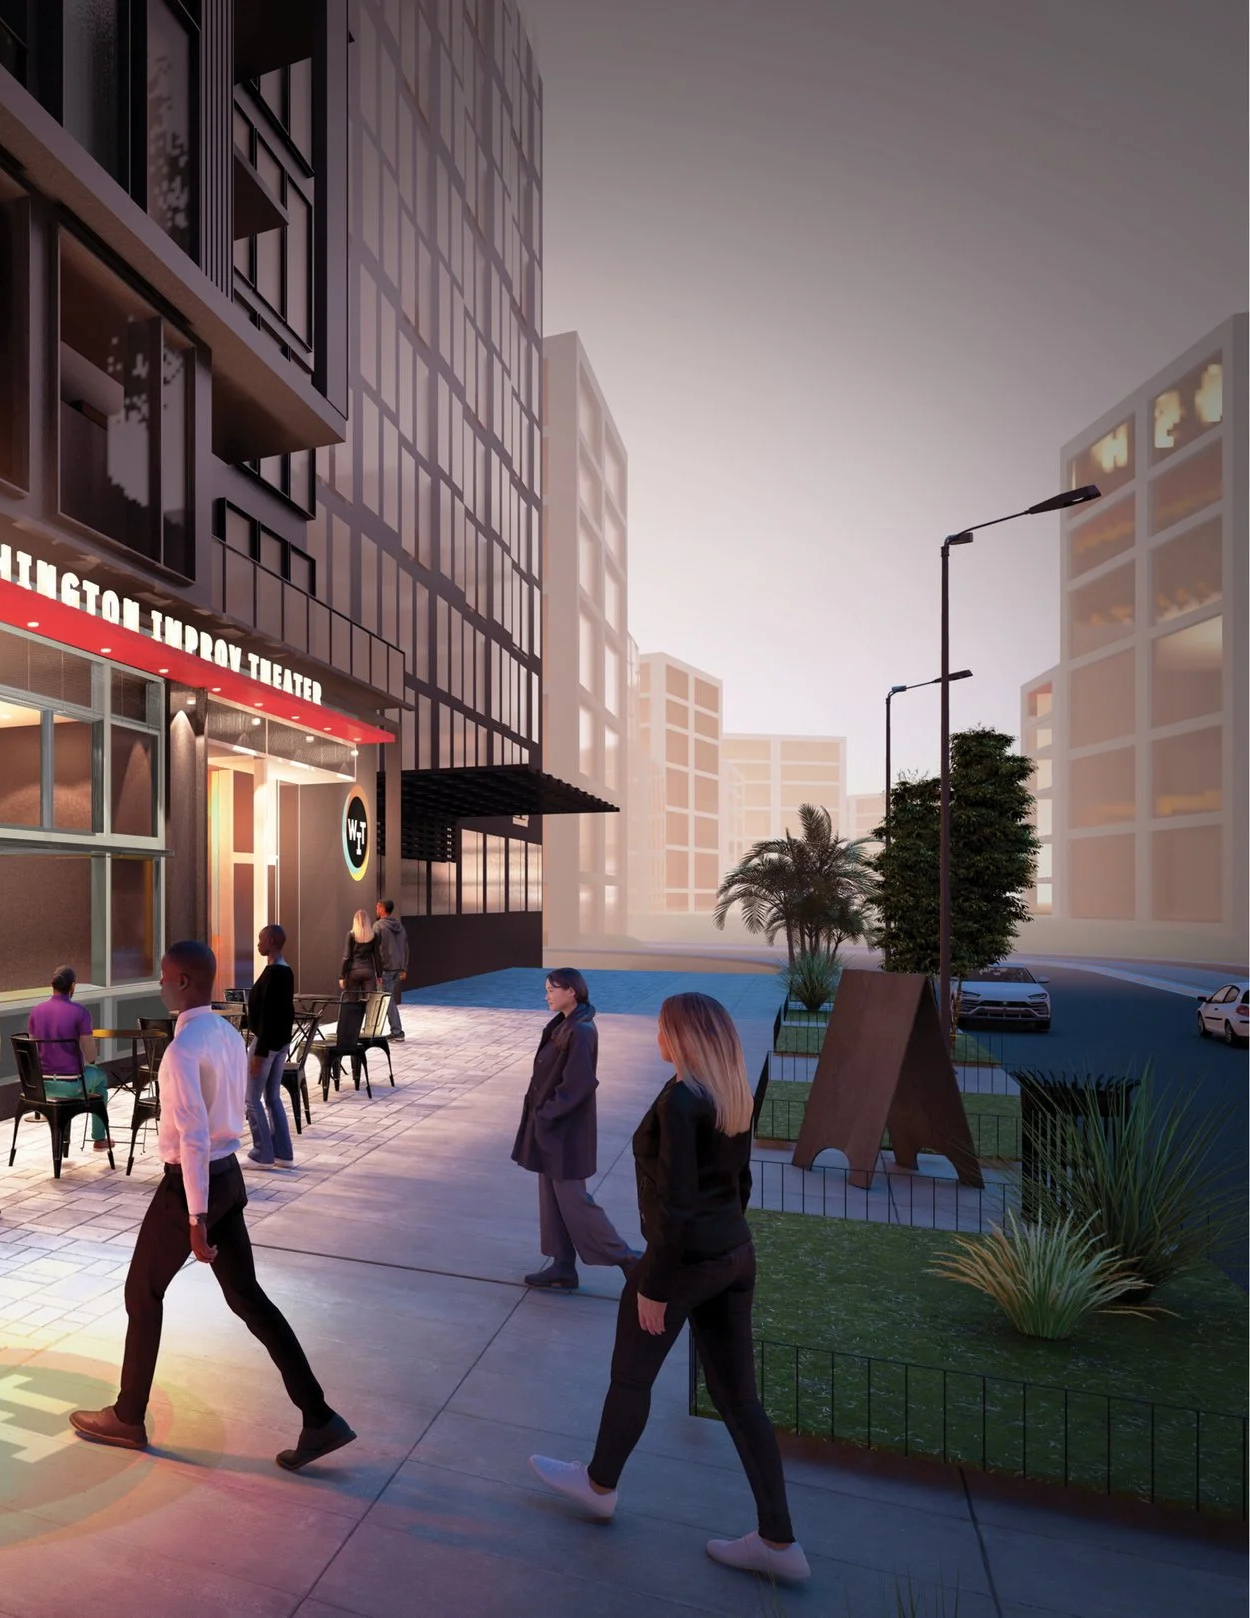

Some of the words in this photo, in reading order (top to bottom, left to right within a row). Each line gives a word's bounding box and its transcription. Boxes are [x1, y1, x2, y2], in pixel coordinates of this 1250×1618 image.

[150, 609, 242, 673] IMPROV
[247, 652, 323, 706] THEATER
[347, 818, 367, 856] WIT
